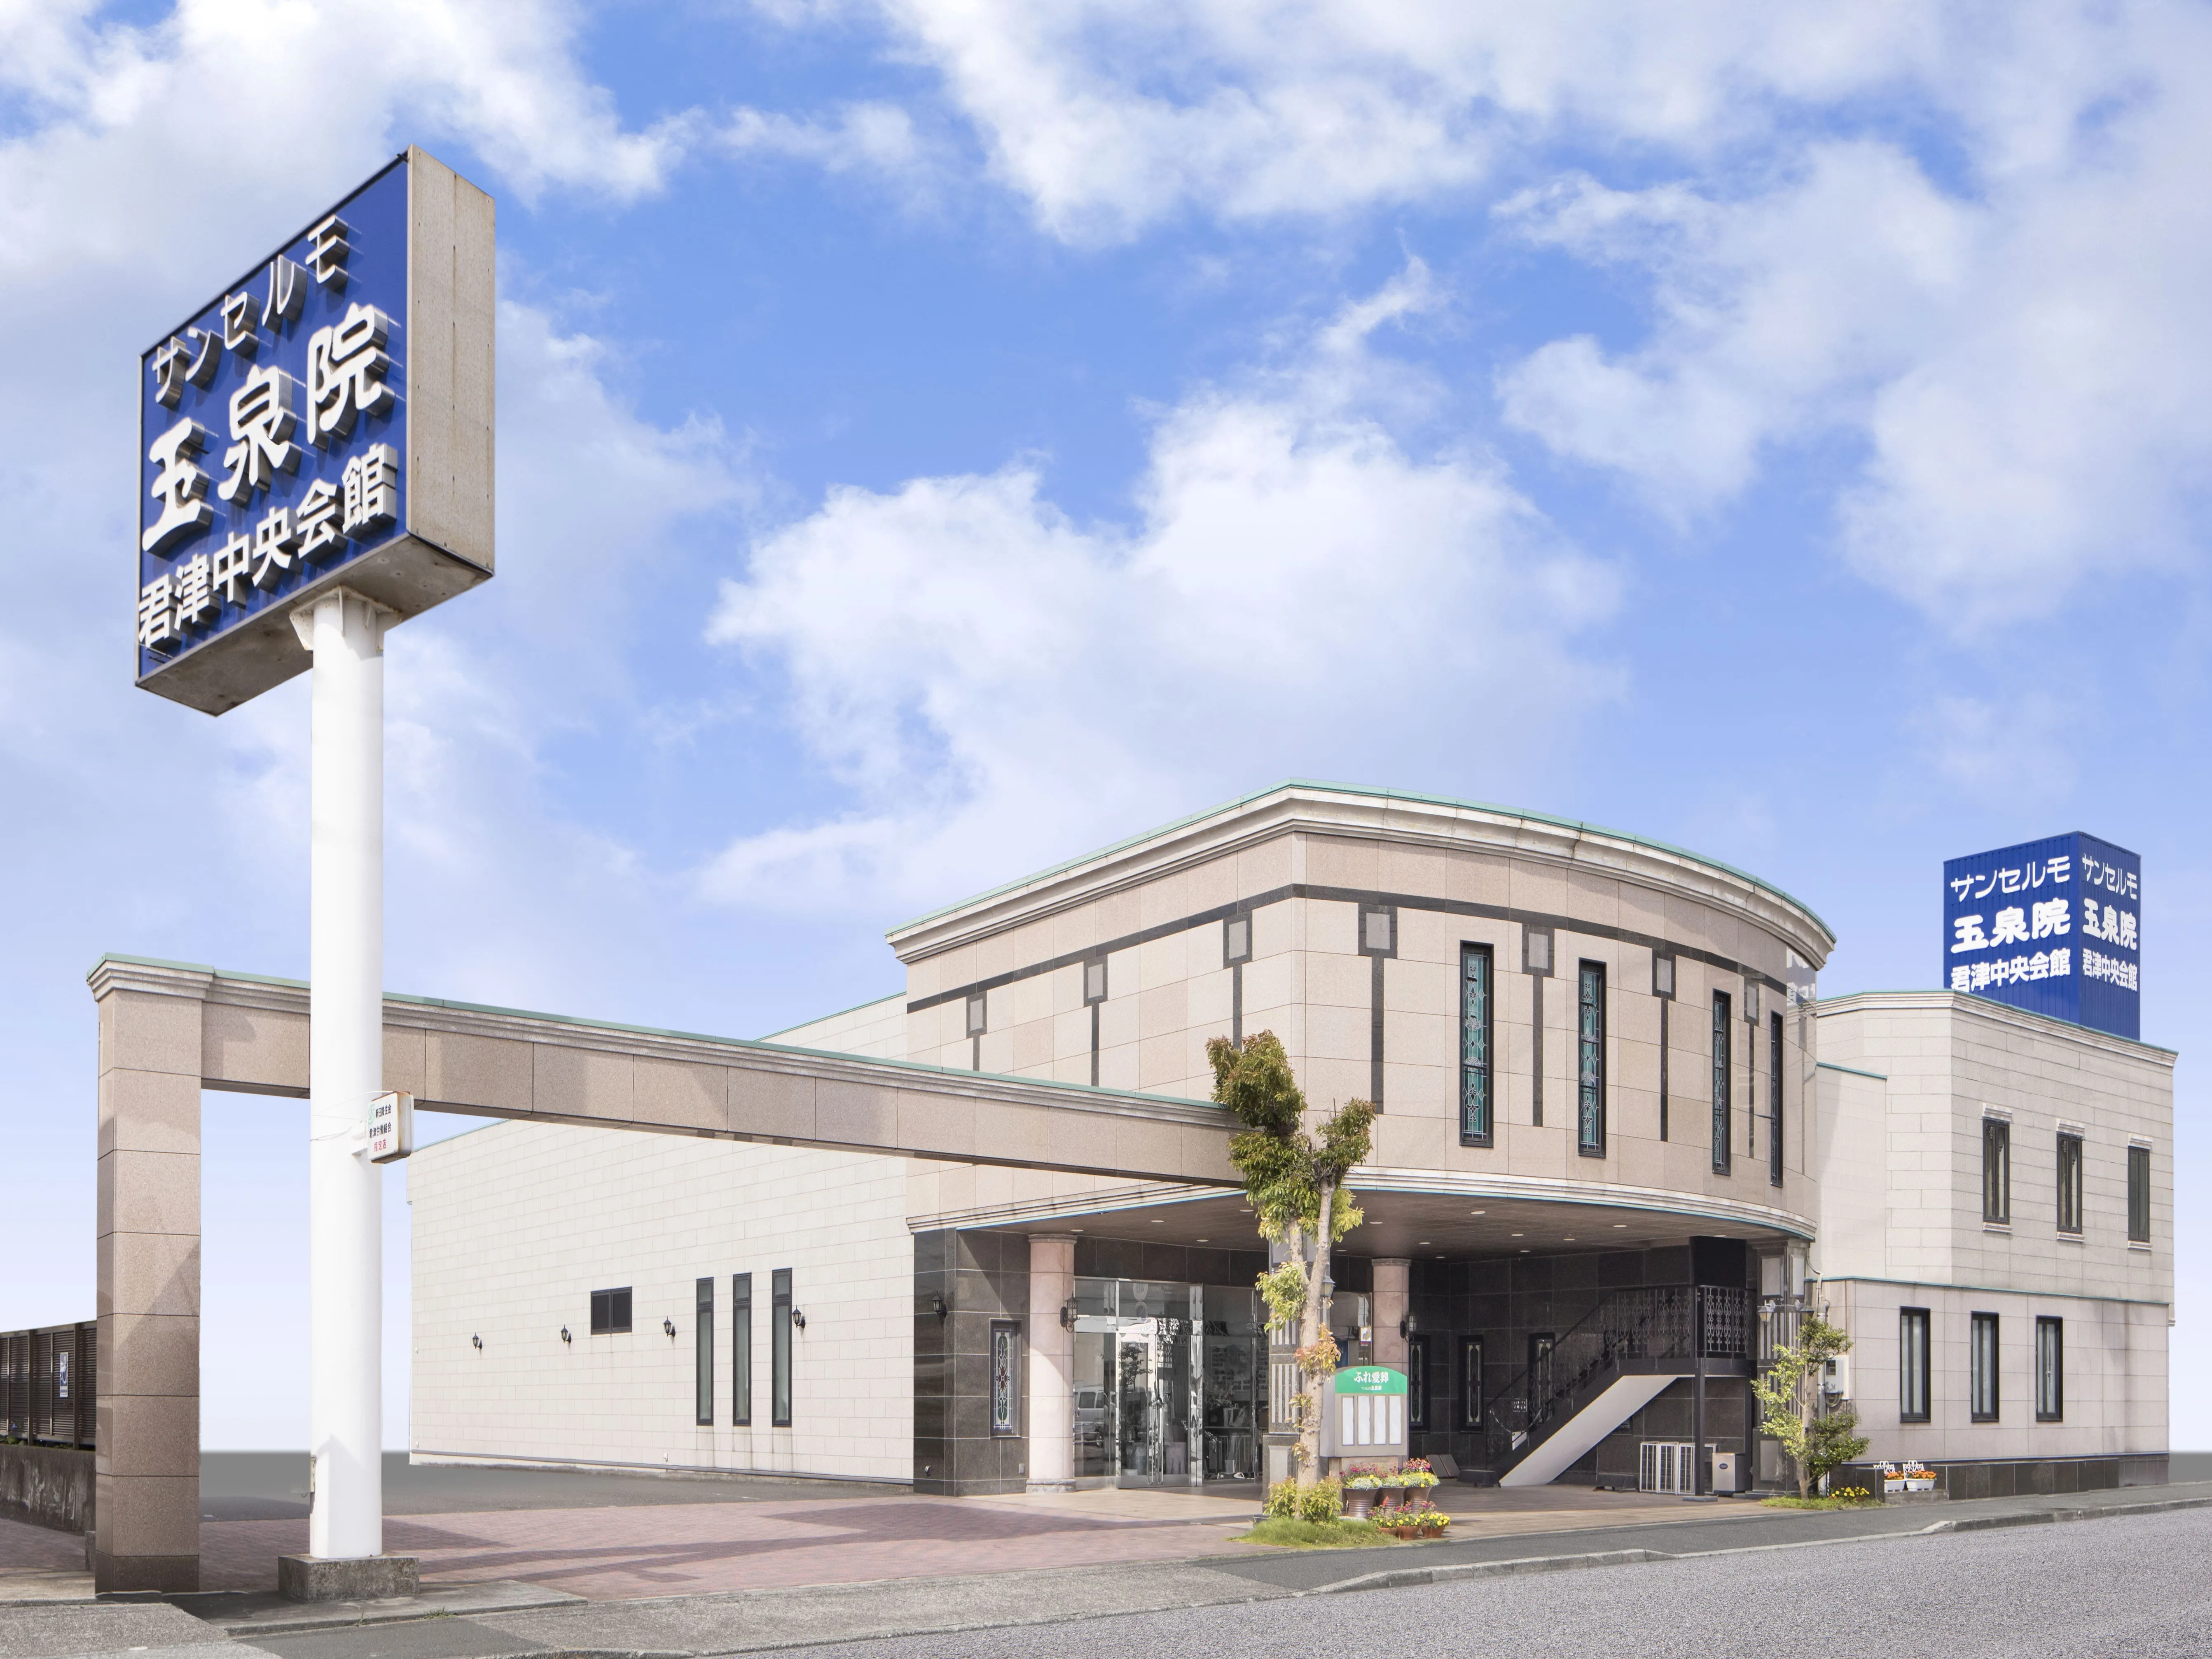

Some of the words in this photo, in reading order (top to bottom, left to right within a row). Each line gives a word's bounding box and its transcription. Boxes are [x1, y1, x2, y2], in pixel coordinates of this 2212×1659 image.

[152, 215, 348, 407] サンセルモ
[142, 302, 390, 554] 玉泉院
[139, 442, 397, 647] 君津中央会館
[1950, 855, 2070, 902] サンセルモ
[2082, 853, 2137, 900] サンセルモ
[1951, 897, 2070, 953] 玉泉院
[2083, 898, 2137, 950] 玉泉院
[1951, 948, 2070, 993] 君津中央会館
[2083, 948, 2137, 992] 君津中央会館
